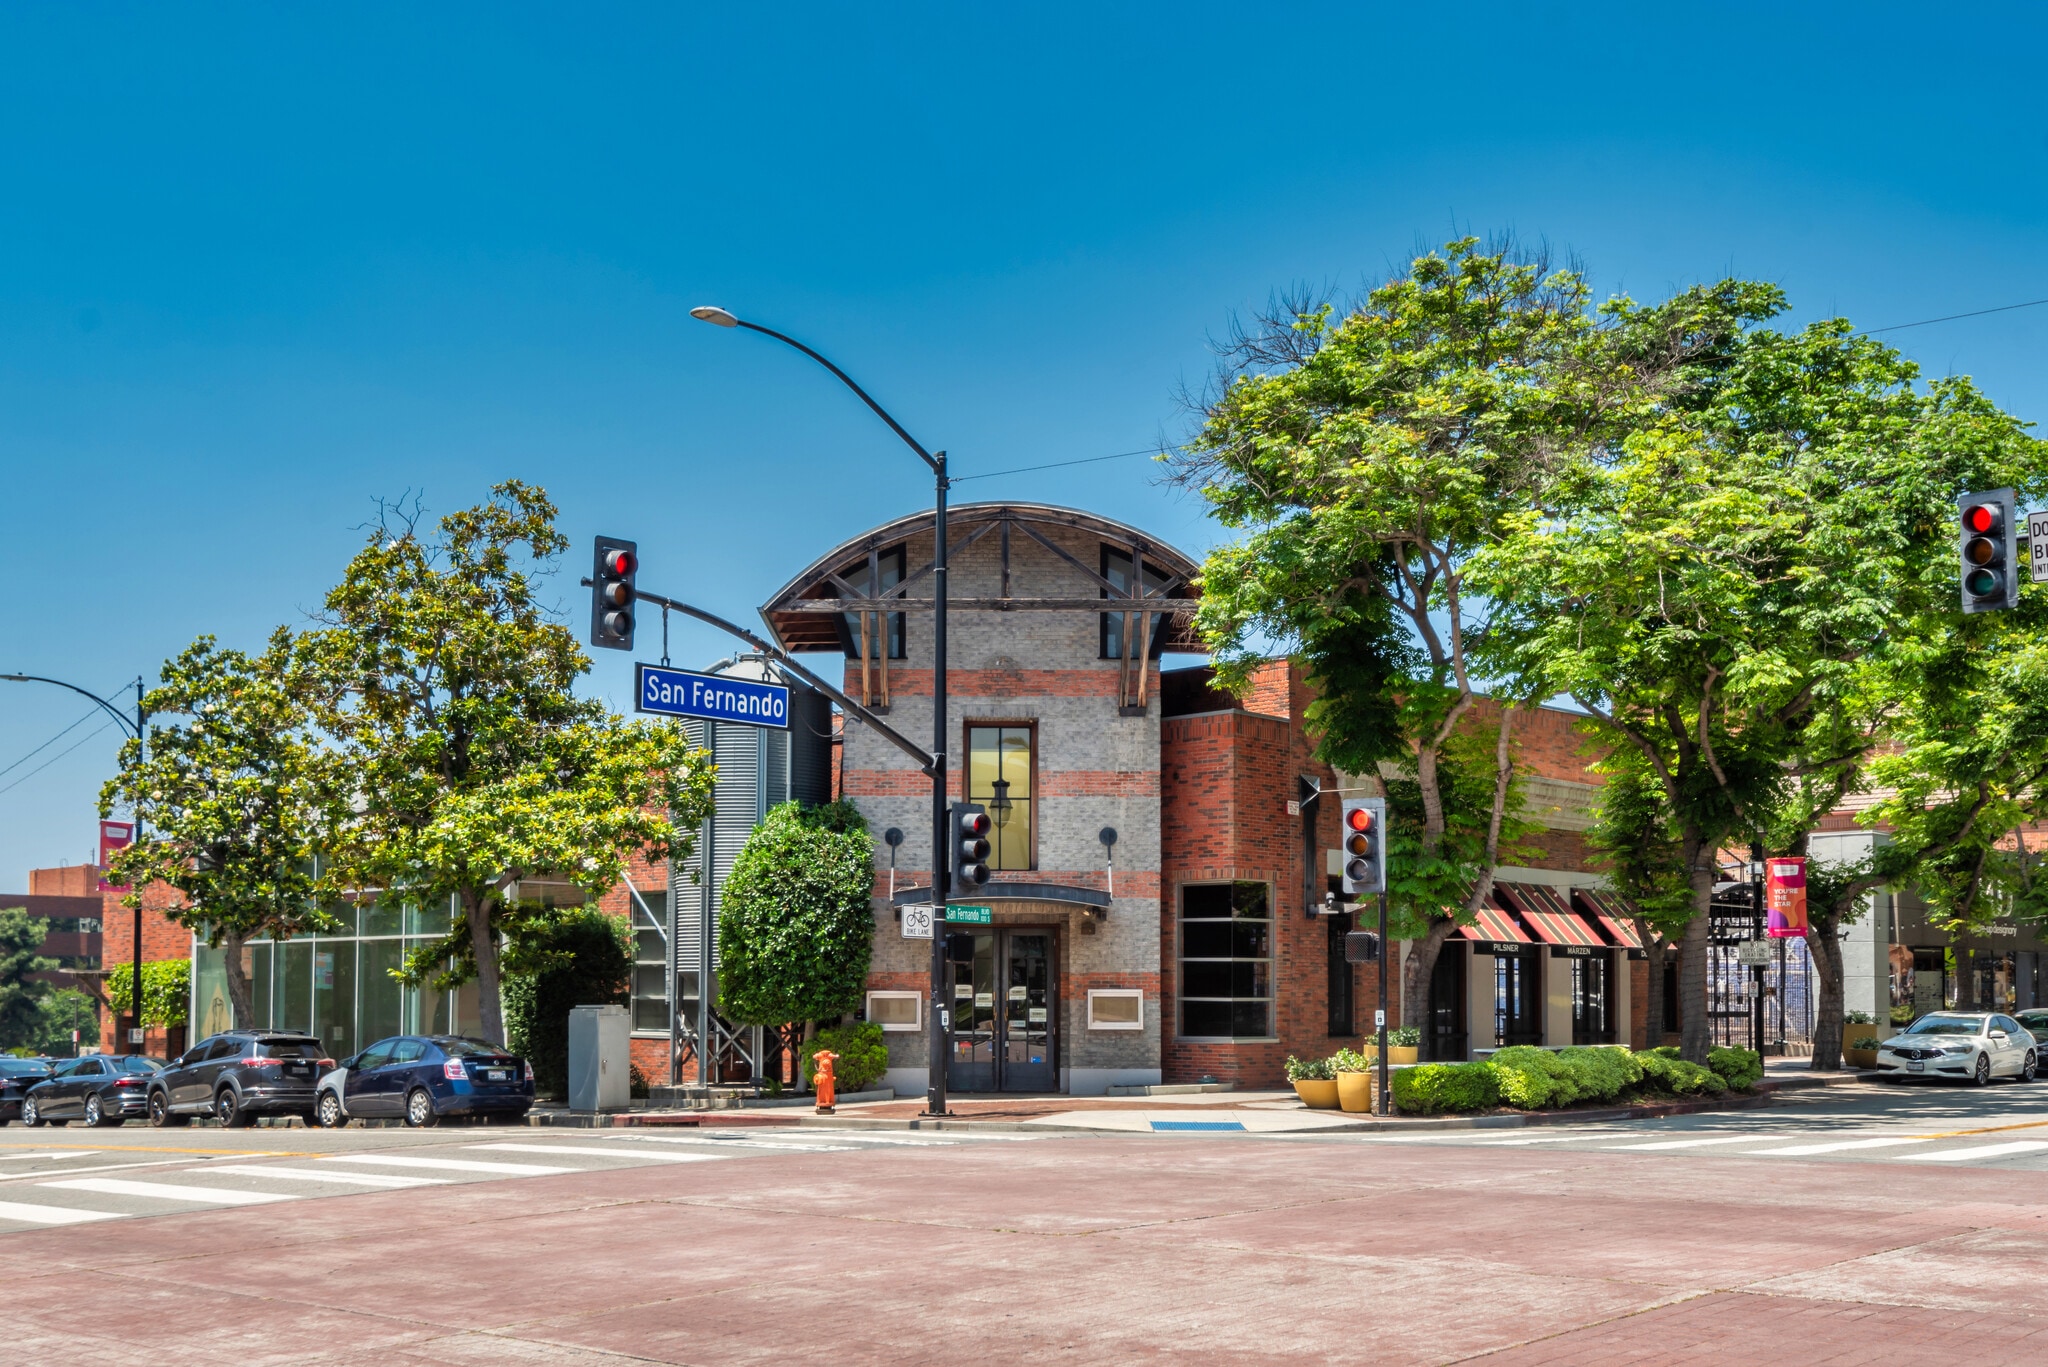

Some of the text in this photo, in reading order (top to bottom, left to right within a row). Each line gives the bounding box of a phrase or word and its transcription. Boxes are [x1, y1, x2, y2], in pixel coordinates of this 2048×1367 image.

[2034, 544, 2048, 559] B
[2035, 563, 2048, 574] INT
[647, 675, 784, 718] San Fernando
[946, 907, 979, 921] San Fernando
[1493, 943, 1519, 952] PILSNER
